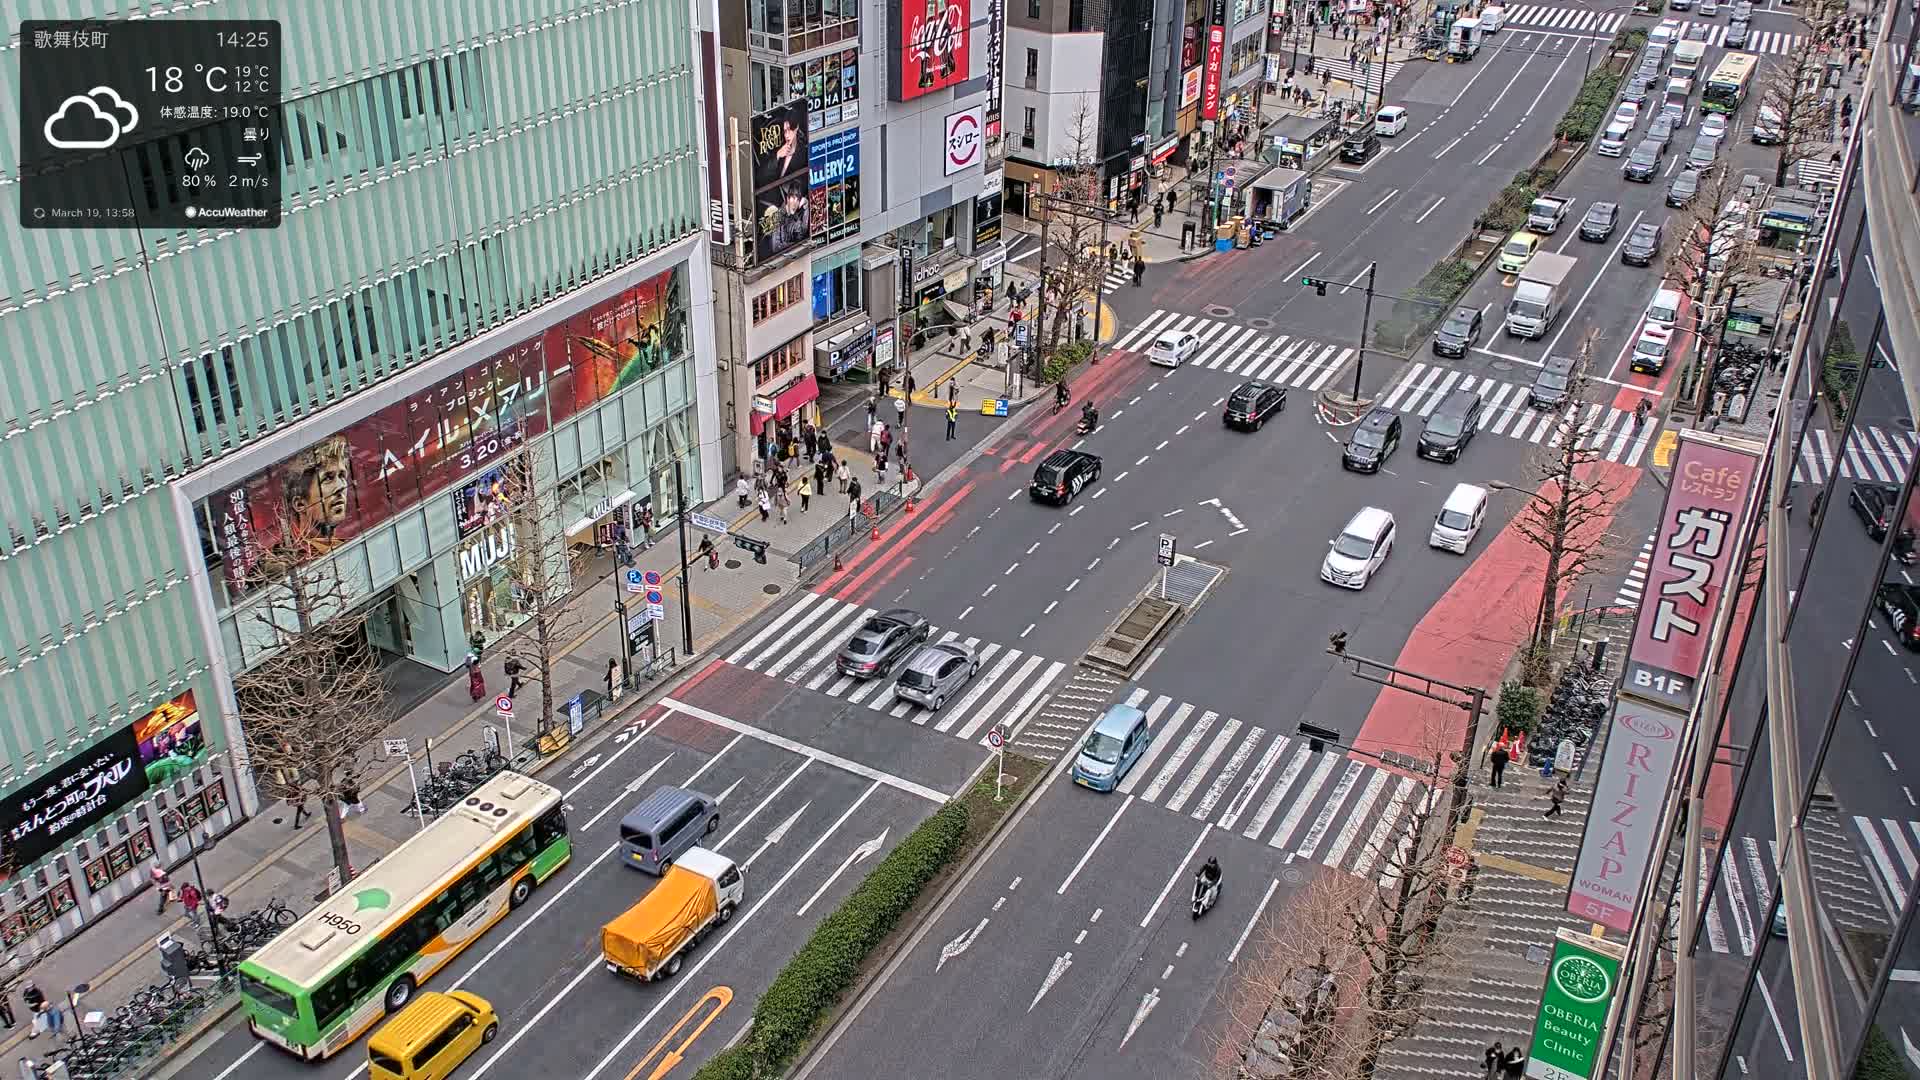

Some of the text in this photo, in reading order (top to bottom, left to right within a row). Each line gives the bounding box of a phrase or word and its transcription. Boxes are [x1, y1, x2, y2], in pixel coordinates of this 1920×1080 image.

[1206, 45, 1220, 110] バーガーキング
[825, 87, 854, 106] HALL
[948, 131, 980, 149] スシロー
[710, 199, 723, 233] MUJI
[1019, 325, 1026, 334] P
[831, 351, 840, 366] P
[409, 340, 542, 412] ライアン・ゴスリング
[446, 377, 504, 412] プロジェクト
[460, 440, 499, 469] 3.20
[1684, 460, 1742, 489] Café
[1679, 479, 1737, 501] レストラン
[593, 496, 612, 519] MUJI
[460, 522, 515, 580] MUJI
[1162, 539, 1169, 548] P
[1650, 506, 1731, 643] ガスト
[1633, 669, 1686, 696] B1F
[22, 752, 115, 812] もう一度、君に会いたい
[1599, 741, 1650, 881] RIZAP
[1579, 879, 1632, 905] WOMAN
[1583, 897, 1613, 921] 5F
[318, 911, 361, 935] H950
[1559, 968, 1601, 992] OBERIA
[1544, 1004, 1598, 1032] OBERIA
[1544, 1020, 1591, 1047] Beauty
[1544, 1039, 1584, 1063] Clinic
